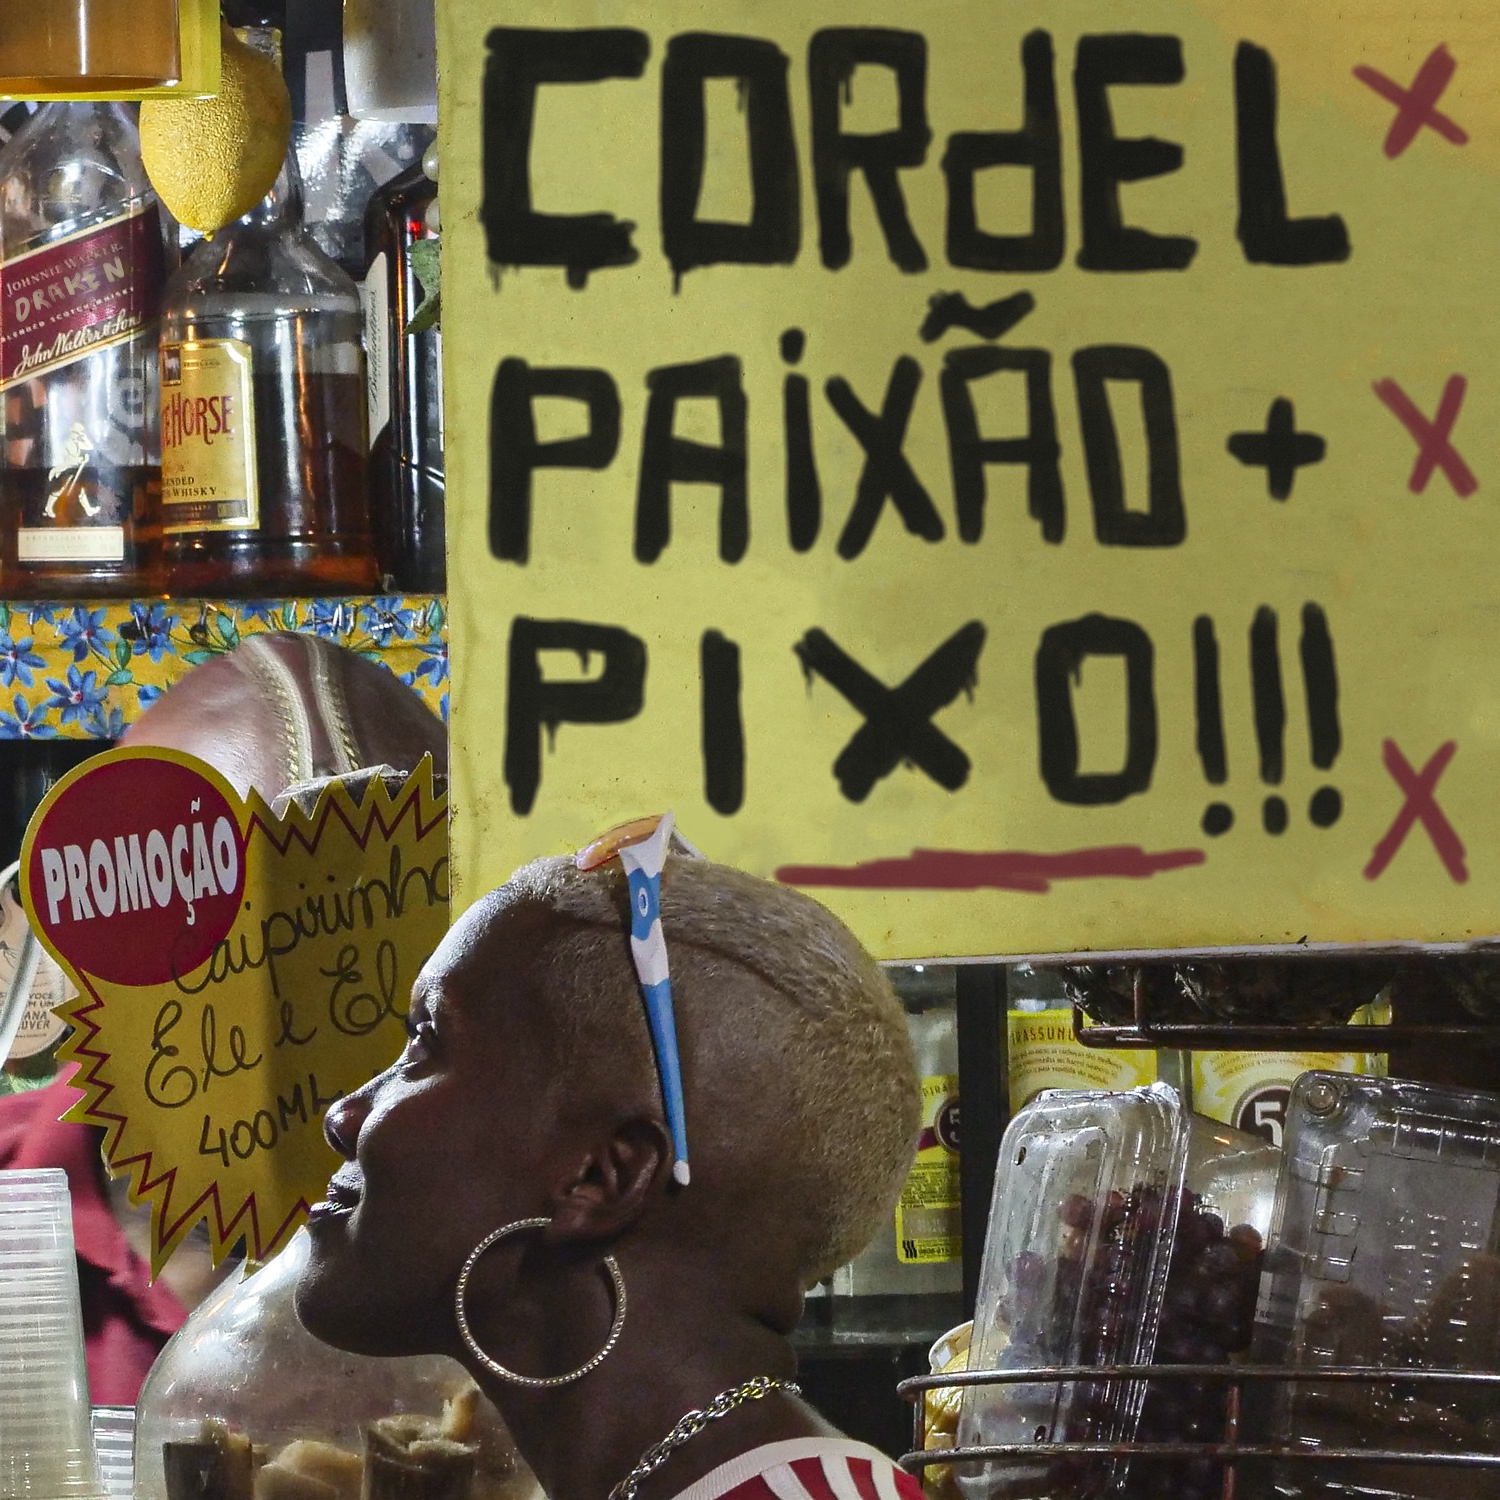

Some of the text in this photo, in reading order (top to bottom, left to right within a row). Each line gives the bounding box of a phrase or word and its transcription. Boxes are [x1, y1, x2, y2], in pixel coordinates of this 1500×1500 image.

[6, 264, 62, 298] JOHNNIE
[14, 255, 125, 324] DRAKEN
[49, 303, 90, 323] SCOTCH
[12, 340, 53, 378] John
[172, 486, 218, 498] WHISKY
[39, 798, 238, 927] PROMOÇÃO
[18, 1020, 50, 1030] OVER
[1012, 1025, 1077, 1045] IRASSUNU
[199, 1072, 344, 1168] 400ML
